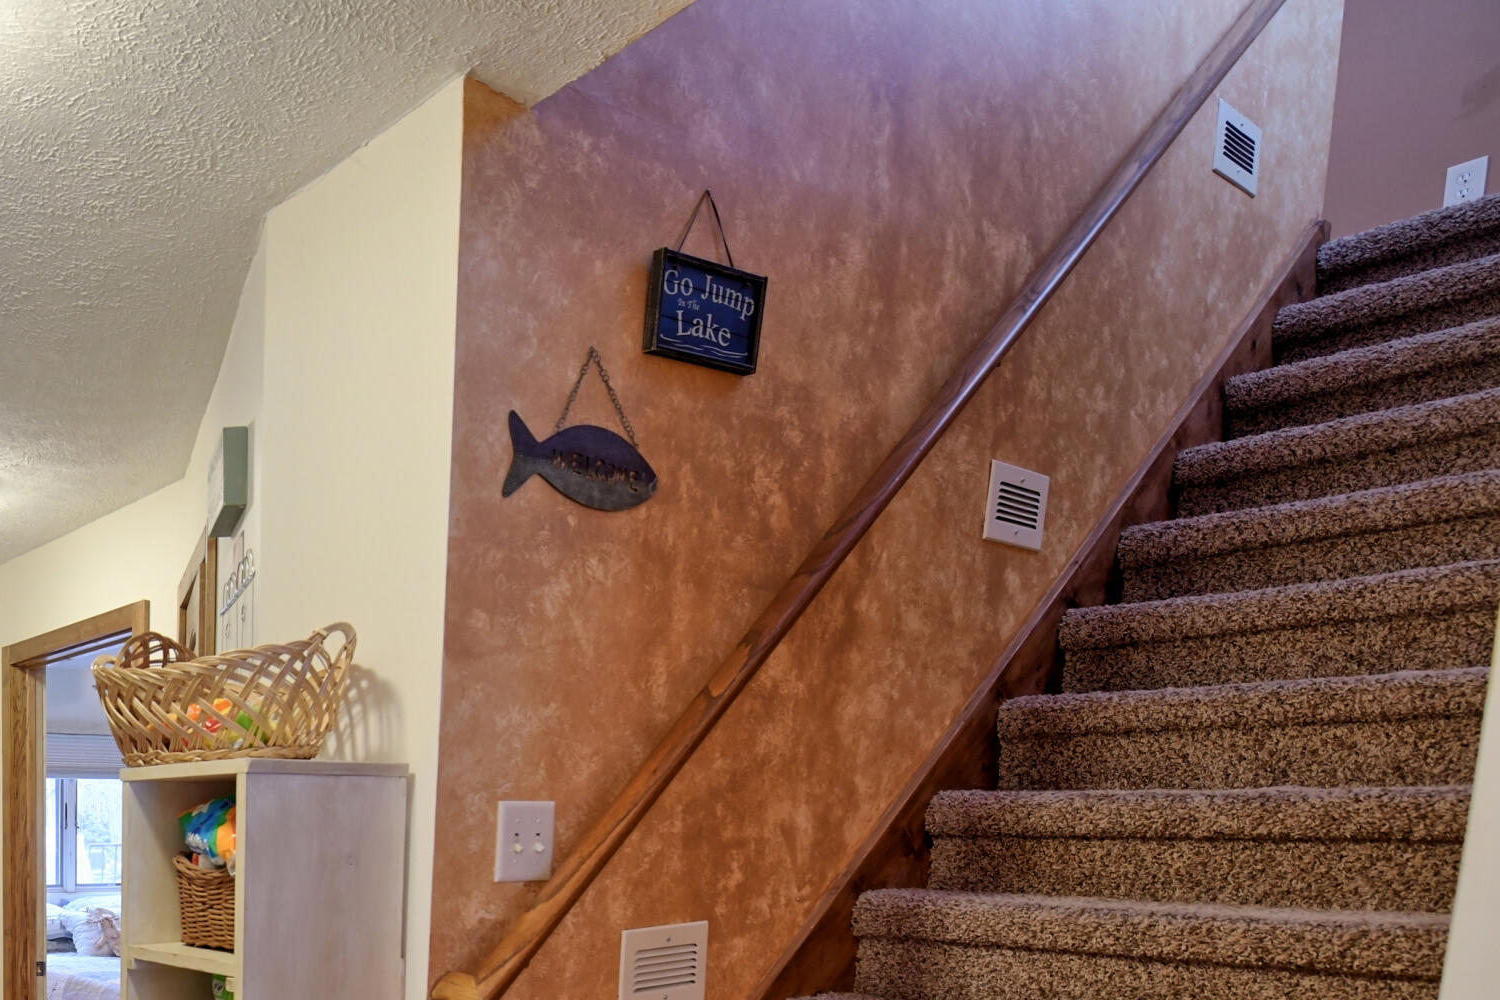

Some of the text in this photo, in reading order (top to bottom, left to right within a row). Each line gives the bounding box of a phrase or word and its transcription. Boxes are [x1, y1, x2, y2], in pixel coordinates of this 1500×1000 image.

[663, 269, 755, 321] Go Jump
[676, 310, 731, 347] Lake
[552, 448, 638, 493] WELCOME
